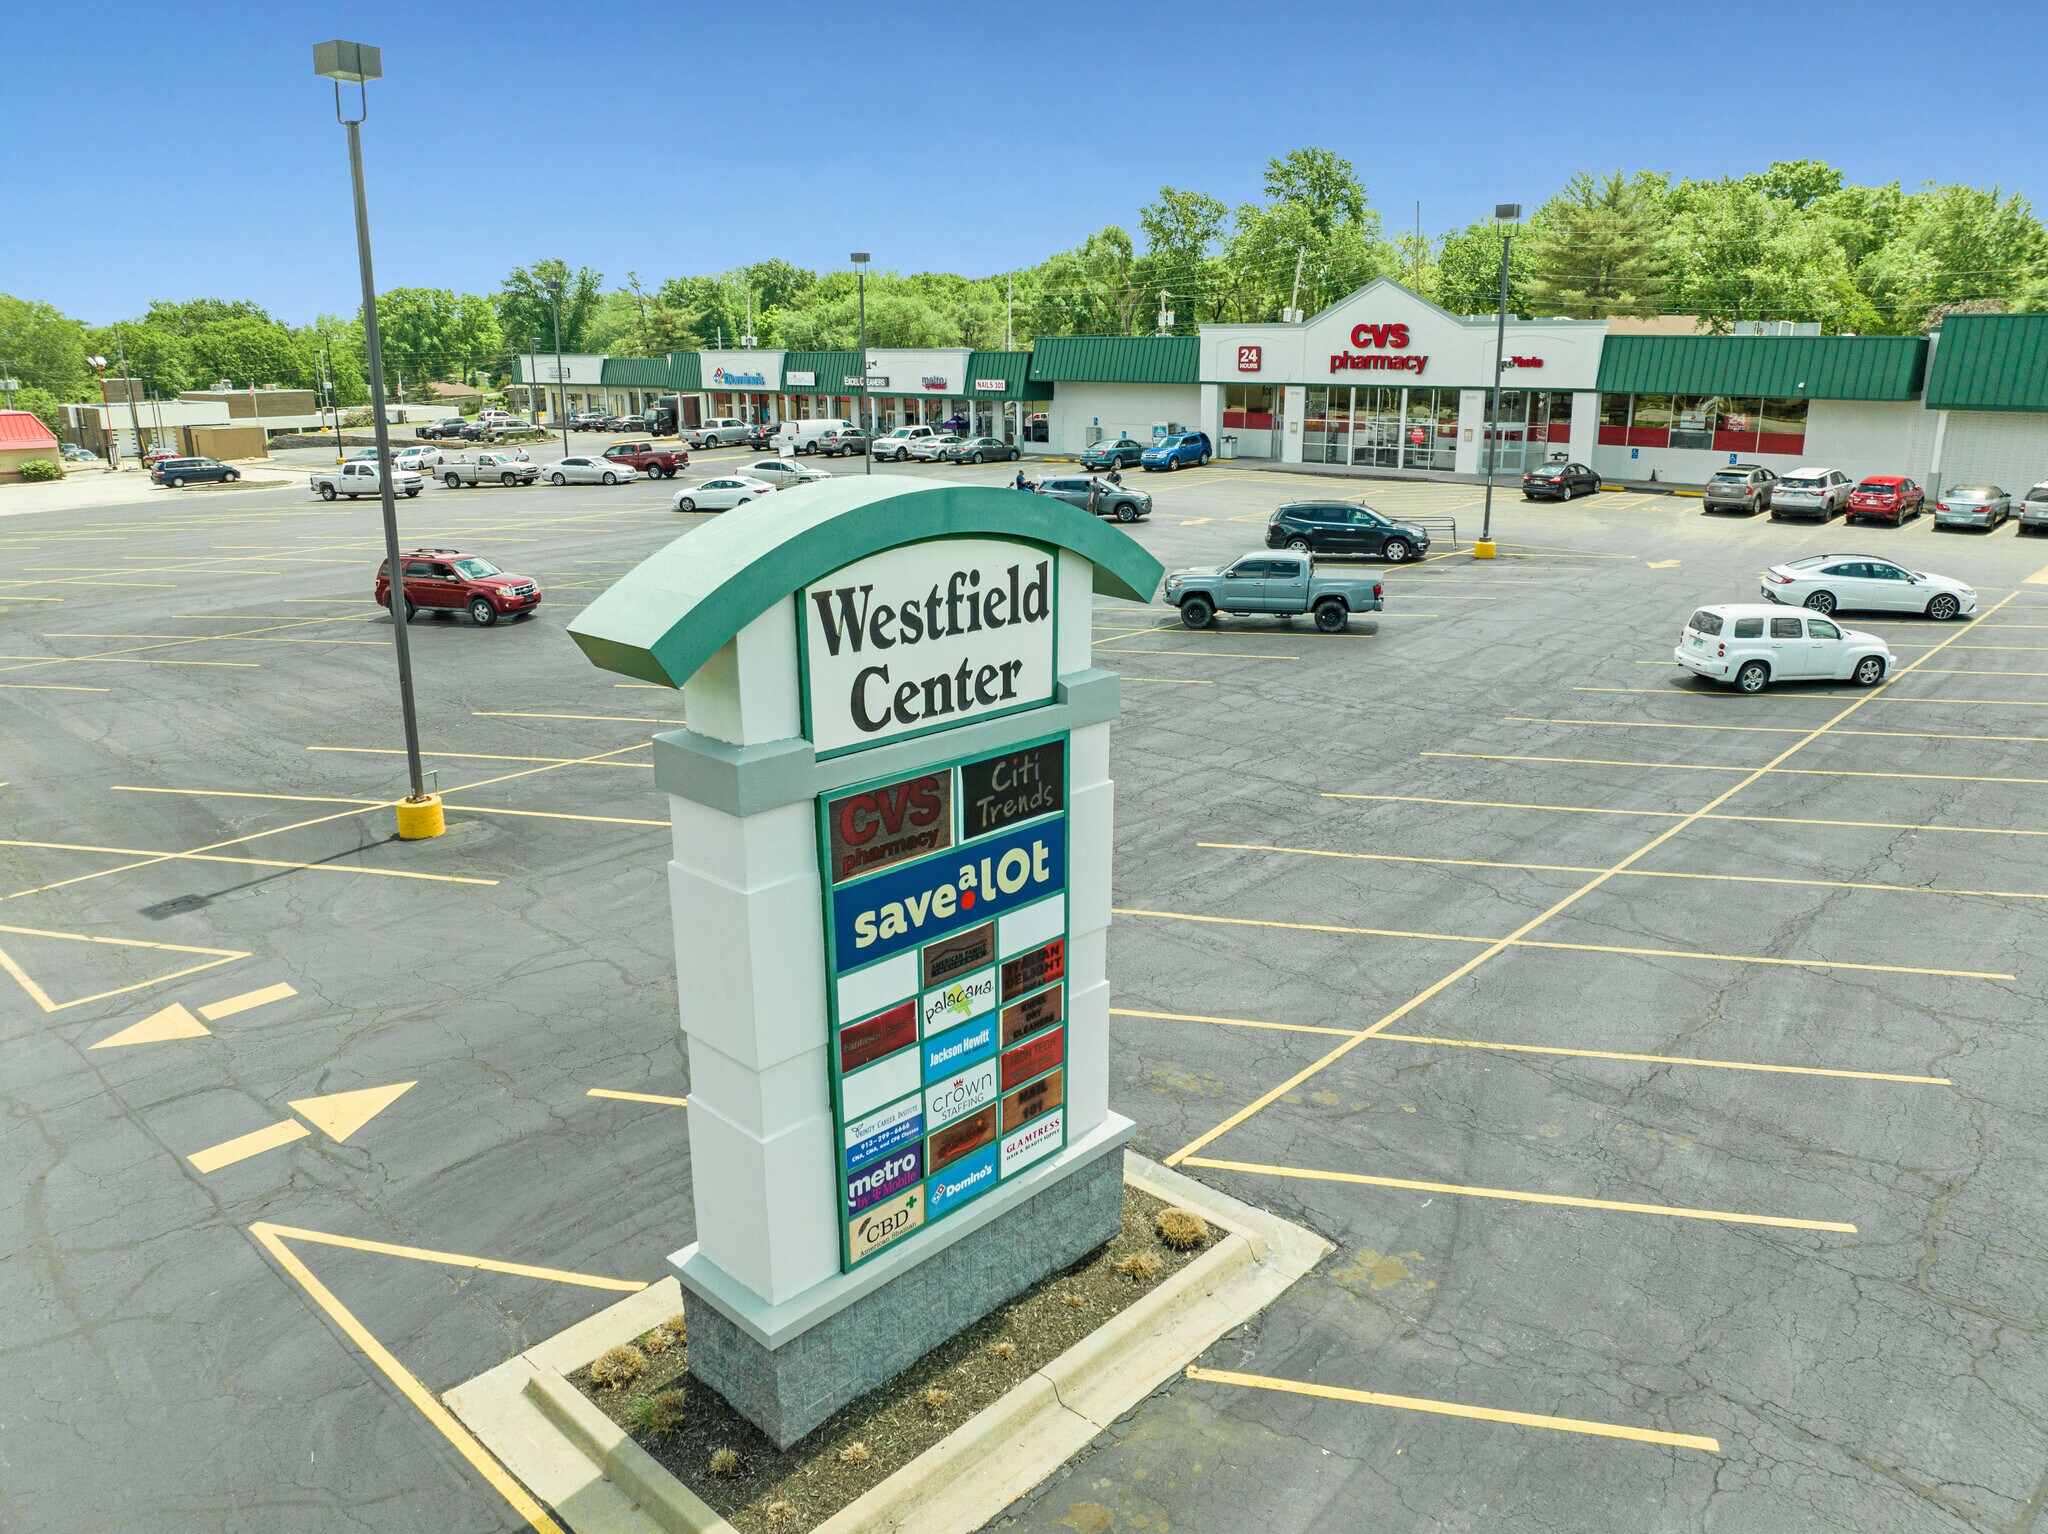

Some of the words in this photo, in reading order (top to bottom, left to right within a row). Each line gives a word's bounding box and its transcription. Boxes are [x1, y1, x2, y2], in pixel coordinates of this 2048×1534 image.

[1351, 323, 1409, 348] CVS
[1240, 349, 1257, 362] 24
[1330, 351, 1428, 375] pharmacy
[724, 372, 764, 385] Domino's
[844, 377, 860, 386] EXCEL
[860, 377, 885, 387] CEANERS
[922, 375, 944, 384] metro
[1729, 413, 1746, 425] 24
[811, 560, 1050, 657] Westfield
[850, 657, 1023, 733] Center
[992, 752, 1039, 791] Citi
[841, 777, 941, 847] CVS
[976, 781, 1053, 828] Trends
[842, 828, 939, 876] pharmacy
[855, 883, 957, 949] save
[931, 952, 963, 969] AMERICAN
[964, 943, 987, 959] FAMILY
[926, 980, 991, 1024] palacana
[1012, 1013, 1054, 1039] CLEANERS
[930, 1043, 962, 1067] Jackson
[963, 1028, 990, 1052] Hewitt
[933, 1073, 992, 1113] crown
[942, 1092, 984, 1120] STAFFING
[1006, 1118, 1060, 1153] GLAMTRESS
[1006, 1151, 1019, 1161] HAIR
[1025, 1138, 1043, 1150] BEAUTY
[1043, 1129, 1060, 1140] SUPPLY
[849, 1153, 916, 1198] metro
[946, 1165, 992, 1197] Domino's
[857, 1196, 870, 1209] by
[860, 1236, 890, 1257] American
[891, 1222, 916, 1240] Shaman
[866, 1209, 909, 1243] CBD
